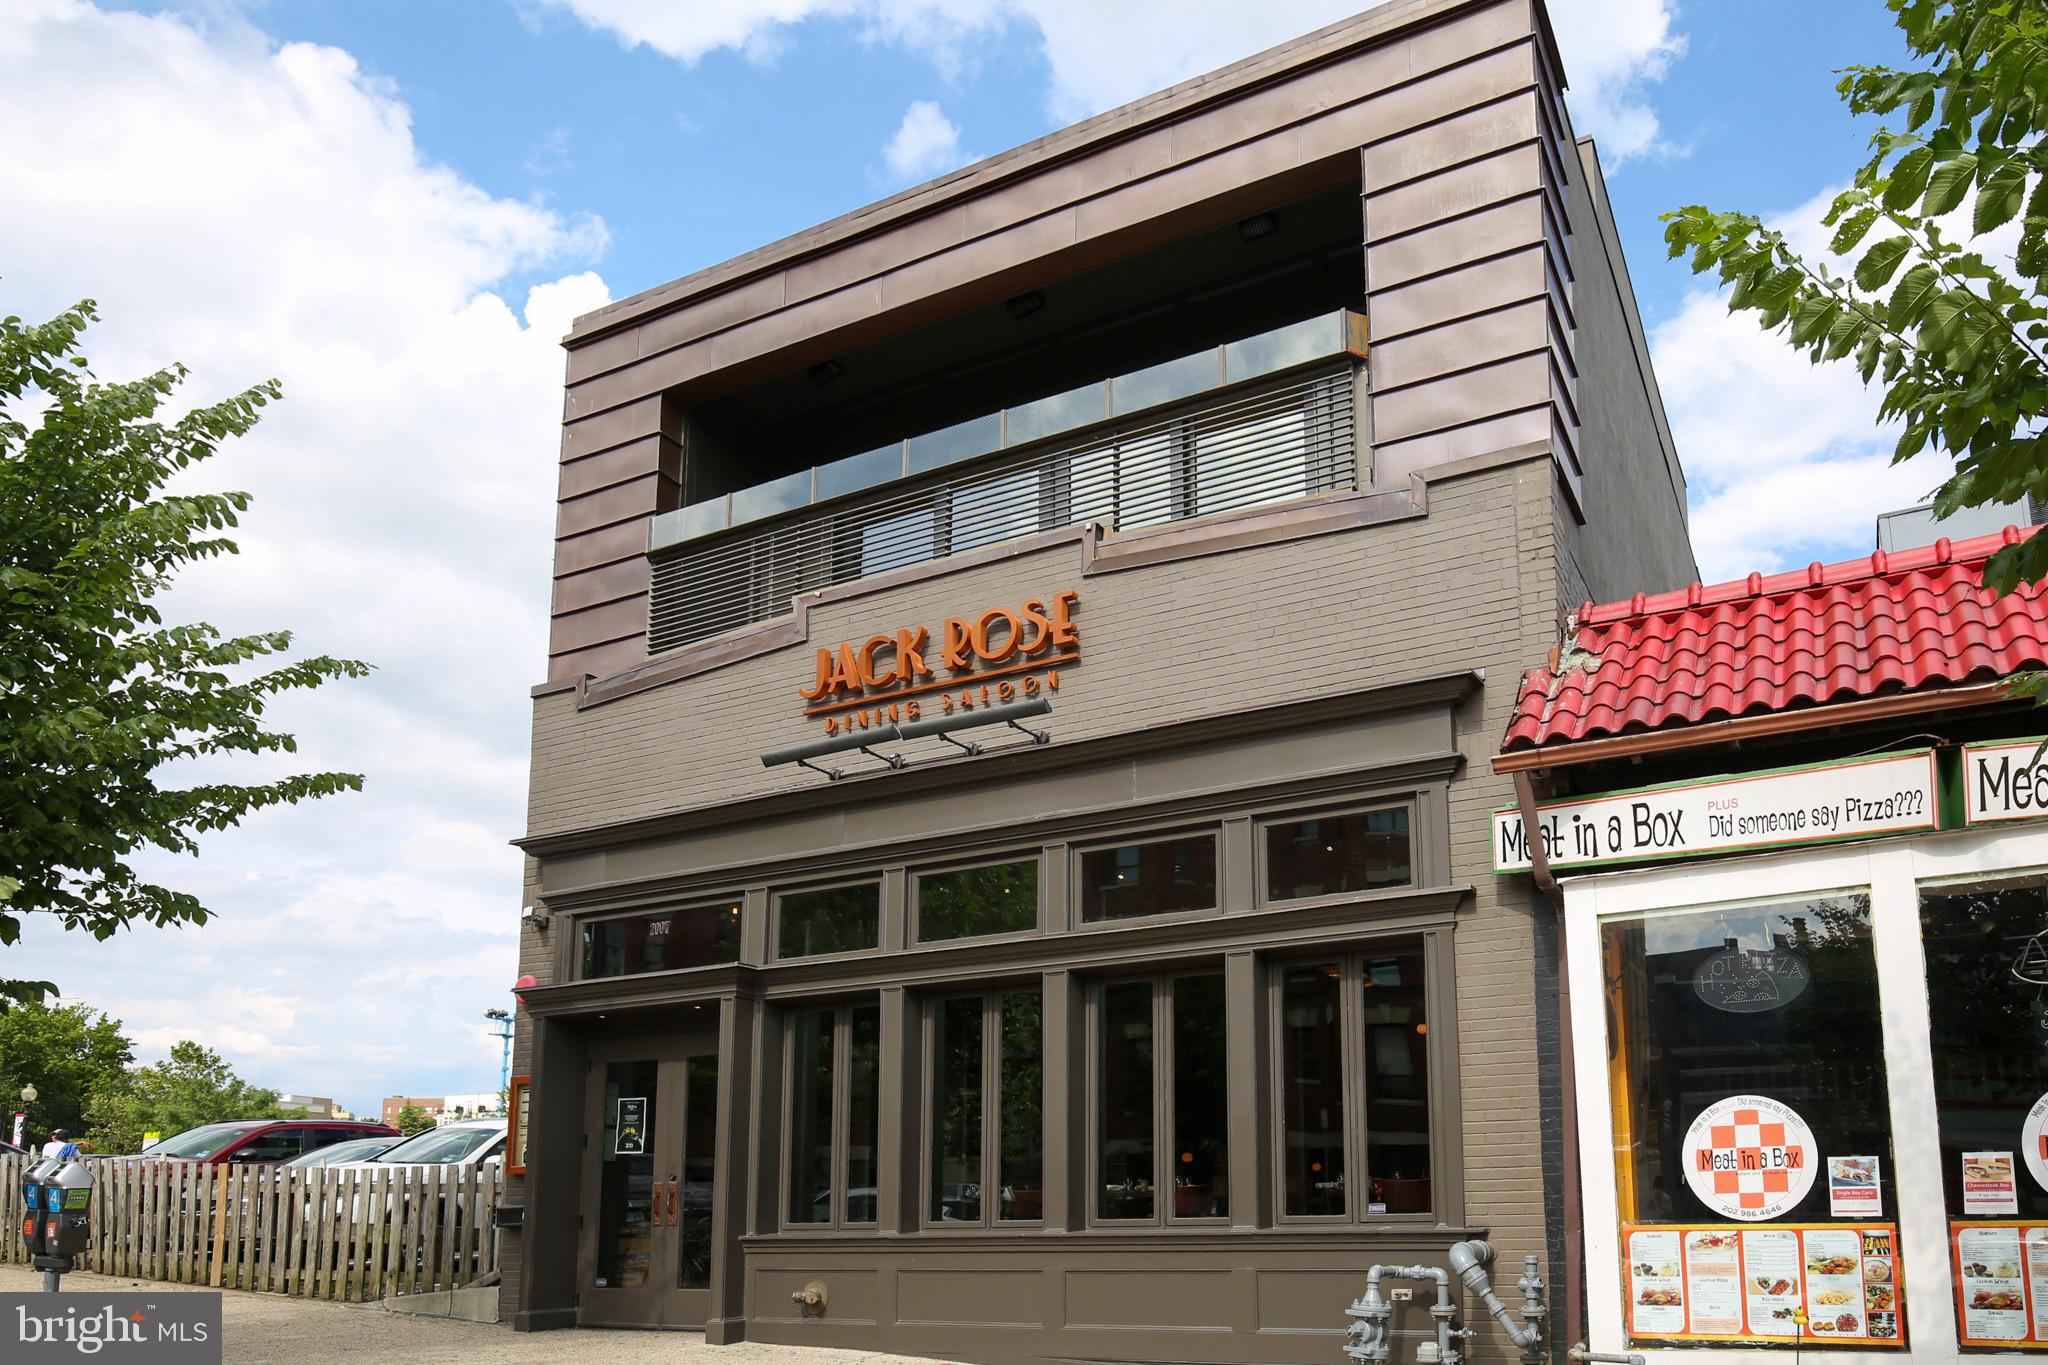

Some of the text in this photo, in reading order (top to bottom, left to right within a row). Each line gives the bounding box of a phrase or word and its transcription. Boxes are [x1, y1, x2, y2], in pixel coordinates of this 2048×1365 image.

[799, 590, 1079, 700] JACK ROSE
[825, 670, 1059, 734] DINING SALOON
[1707, 798, 1739, 812] PLUS
[1709, 789, 1923, 837] Did someone say Pizza???
[1572, 814, 1599, 858] in
[1607, 815, 1622, 852] a
[1631, 802, 1686, 848] Box
[1701, 1147, 1800, 1170] Meat in a Box
[50, 1190, 58, 1204] 4
[1721, 1203, 1782, 1217] 202.986.4646
